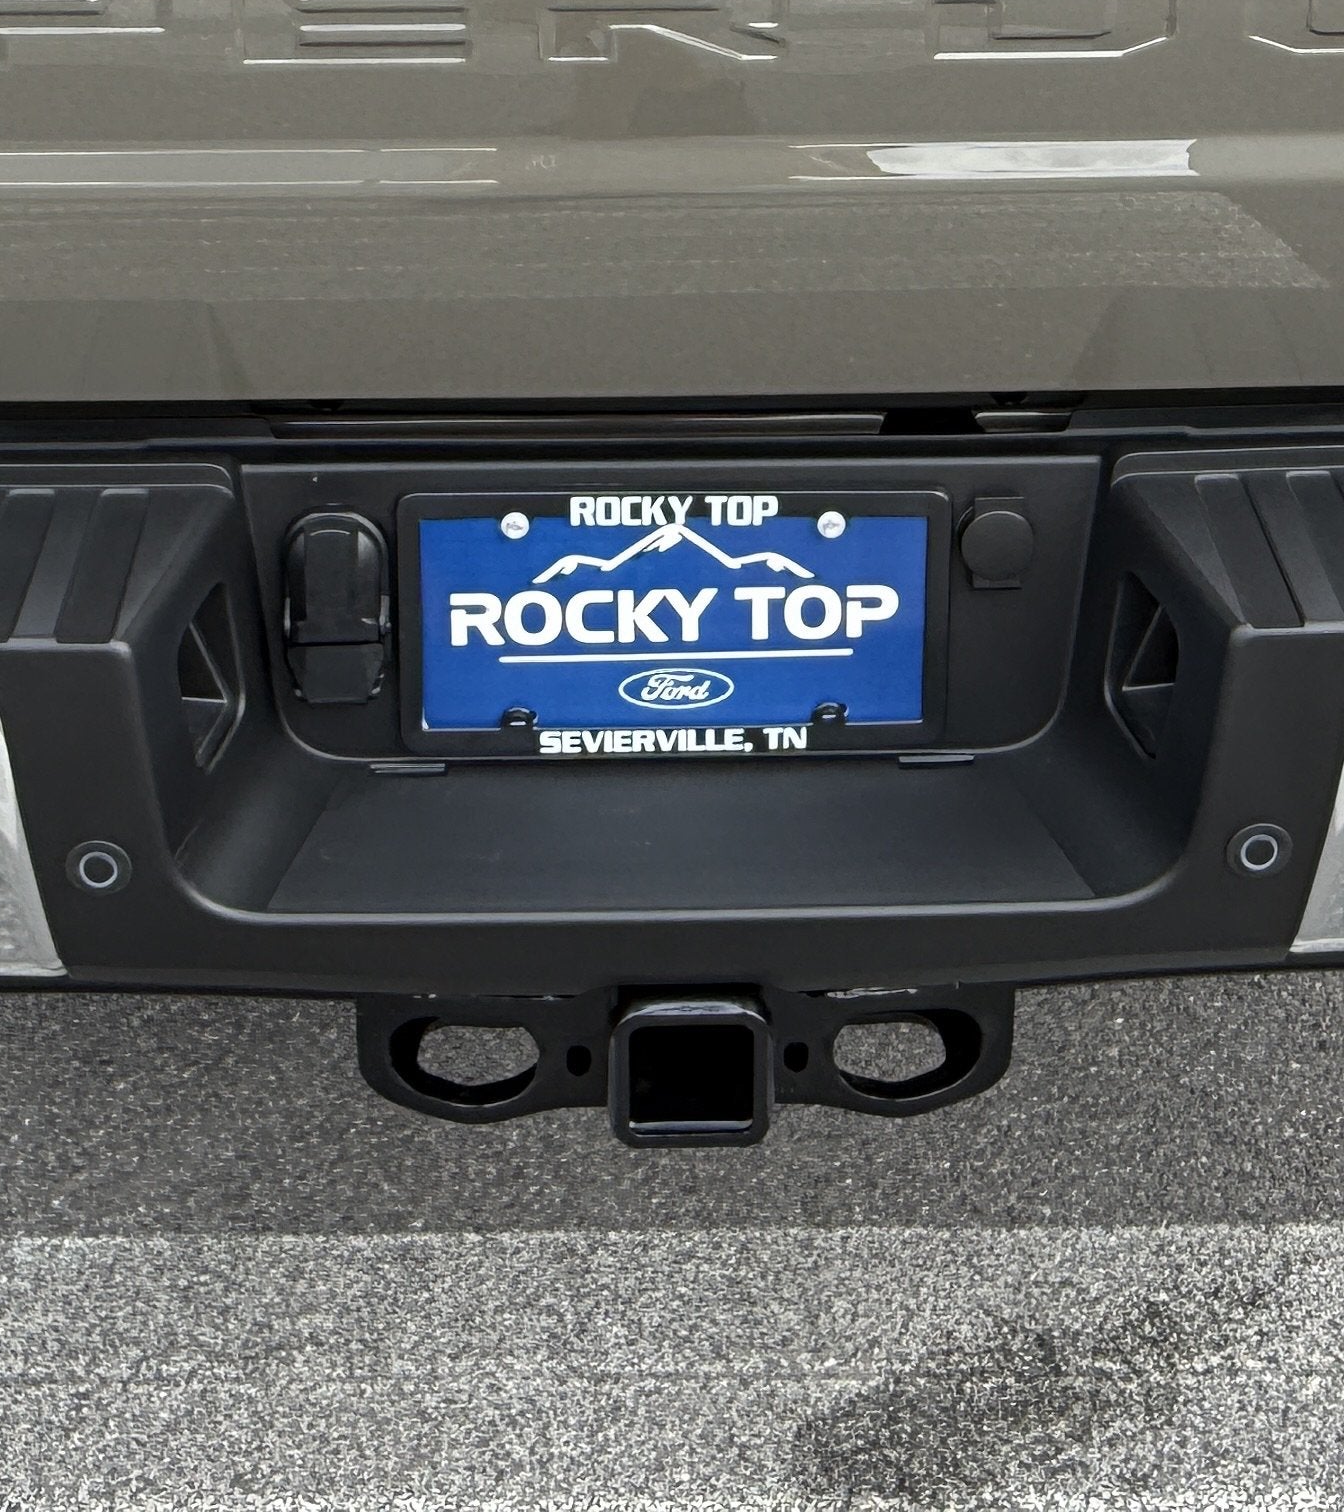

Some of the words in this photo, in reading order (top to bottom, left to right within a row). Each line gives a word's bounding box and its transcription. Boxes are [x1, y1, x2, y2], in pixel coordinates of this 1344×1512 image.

[568, 495, 694, 527] ROCKY
[704, 495, 779, 526] TOP
[449, 587, 719, 647] ROCKY
[733, 584, 900, 641] TOP
[640, 673, 710, 704] Ford
[538, 726, 754, 755] SEVIERVILLE,
[762, 726, 808, 751] TN
